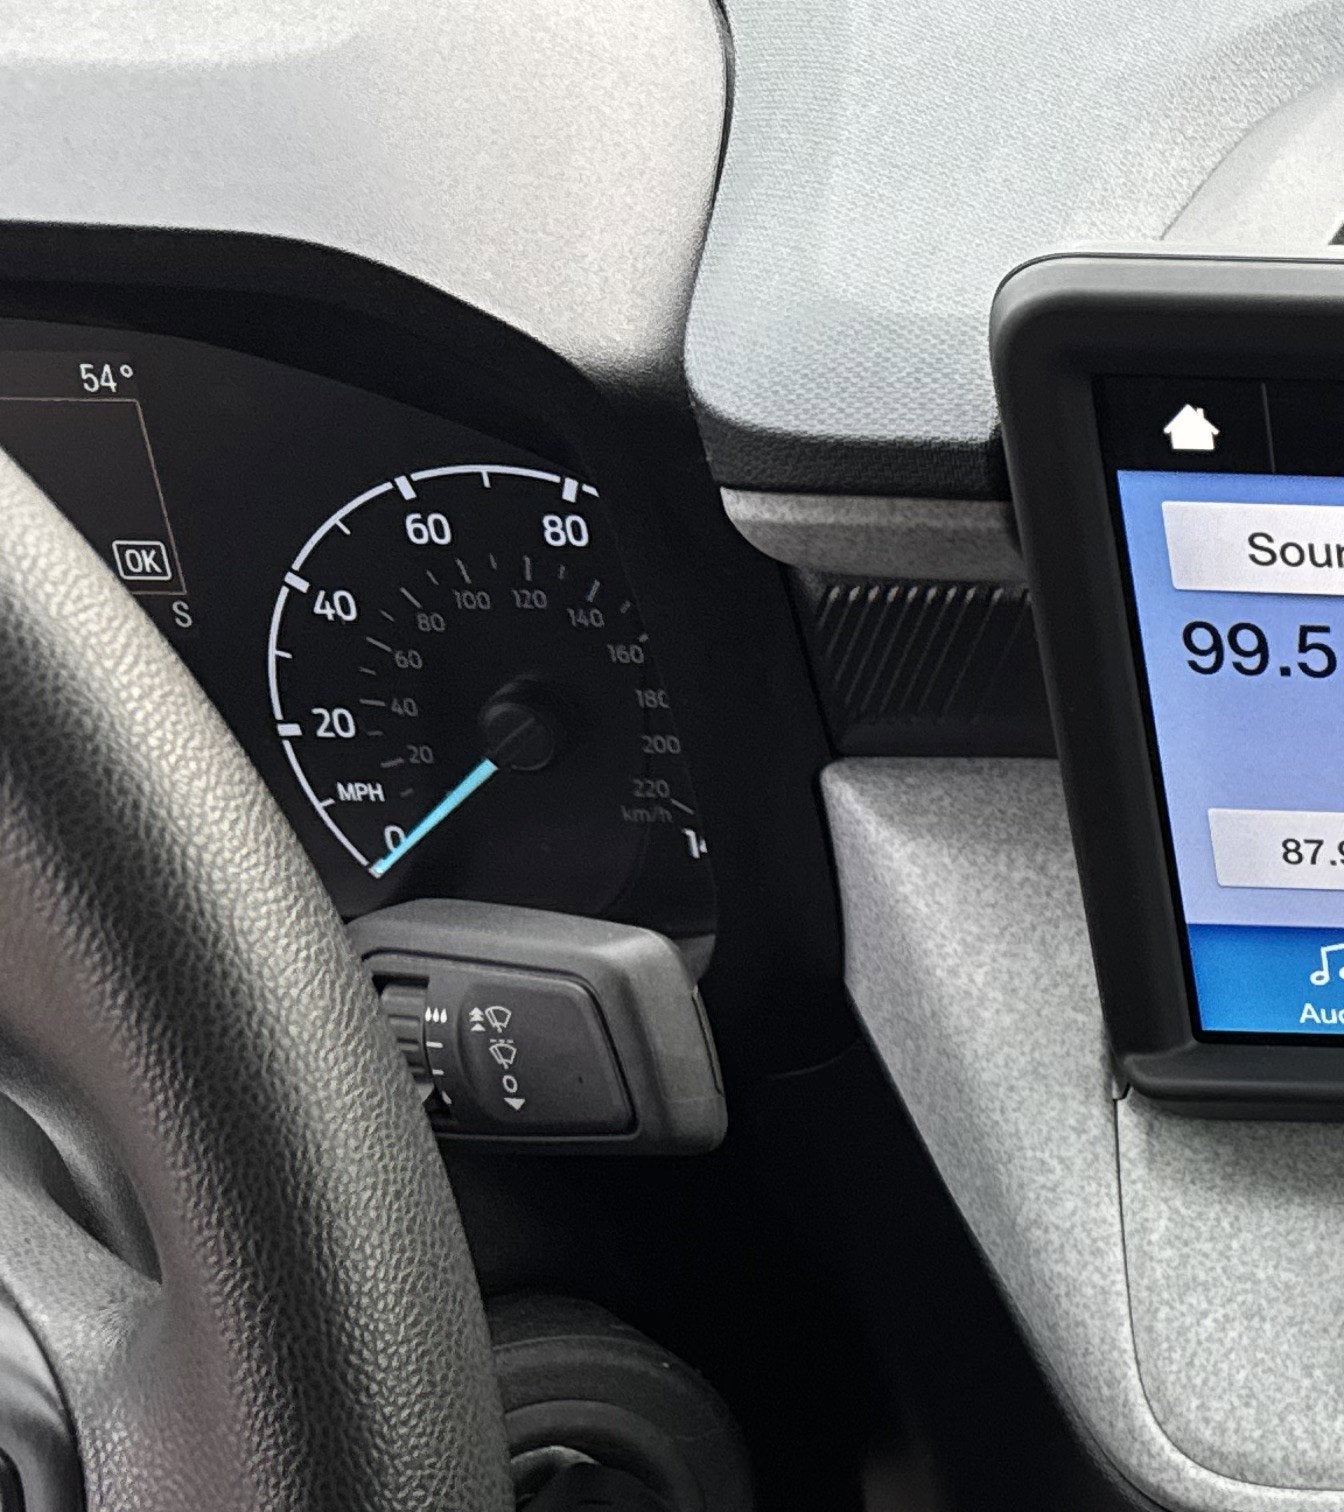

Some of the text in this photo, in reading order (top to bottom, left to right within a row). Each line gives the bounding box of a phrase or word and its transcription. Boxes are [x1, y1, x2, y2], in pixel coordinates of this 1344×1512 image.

[406, 513, 451, 545] 60
[543, 515, 588, 546] 80
[124, 549, 161, 574] OK
[314, 590, 357, 621] 40
[455, 590, 490, 610] 100
[512, 590, 547, 609] 120
[173, 601, 192, 628] S
[417, 613, 445, 633] 80
[569, 608, 604, 628] 140
[395, 649, 422, 669] 60
[608, 644, 643, 664] 160
[1181, 620, 1338, 678] 99.5
[391, 698, 418, 717] 40
[311, 708, 355, 738] 20
[408, 745, 434, 764] 20
[641, 735, 681, 754] 200
[338, 783, 385, 803] MPH
[632, 778, 670, 798] 220
